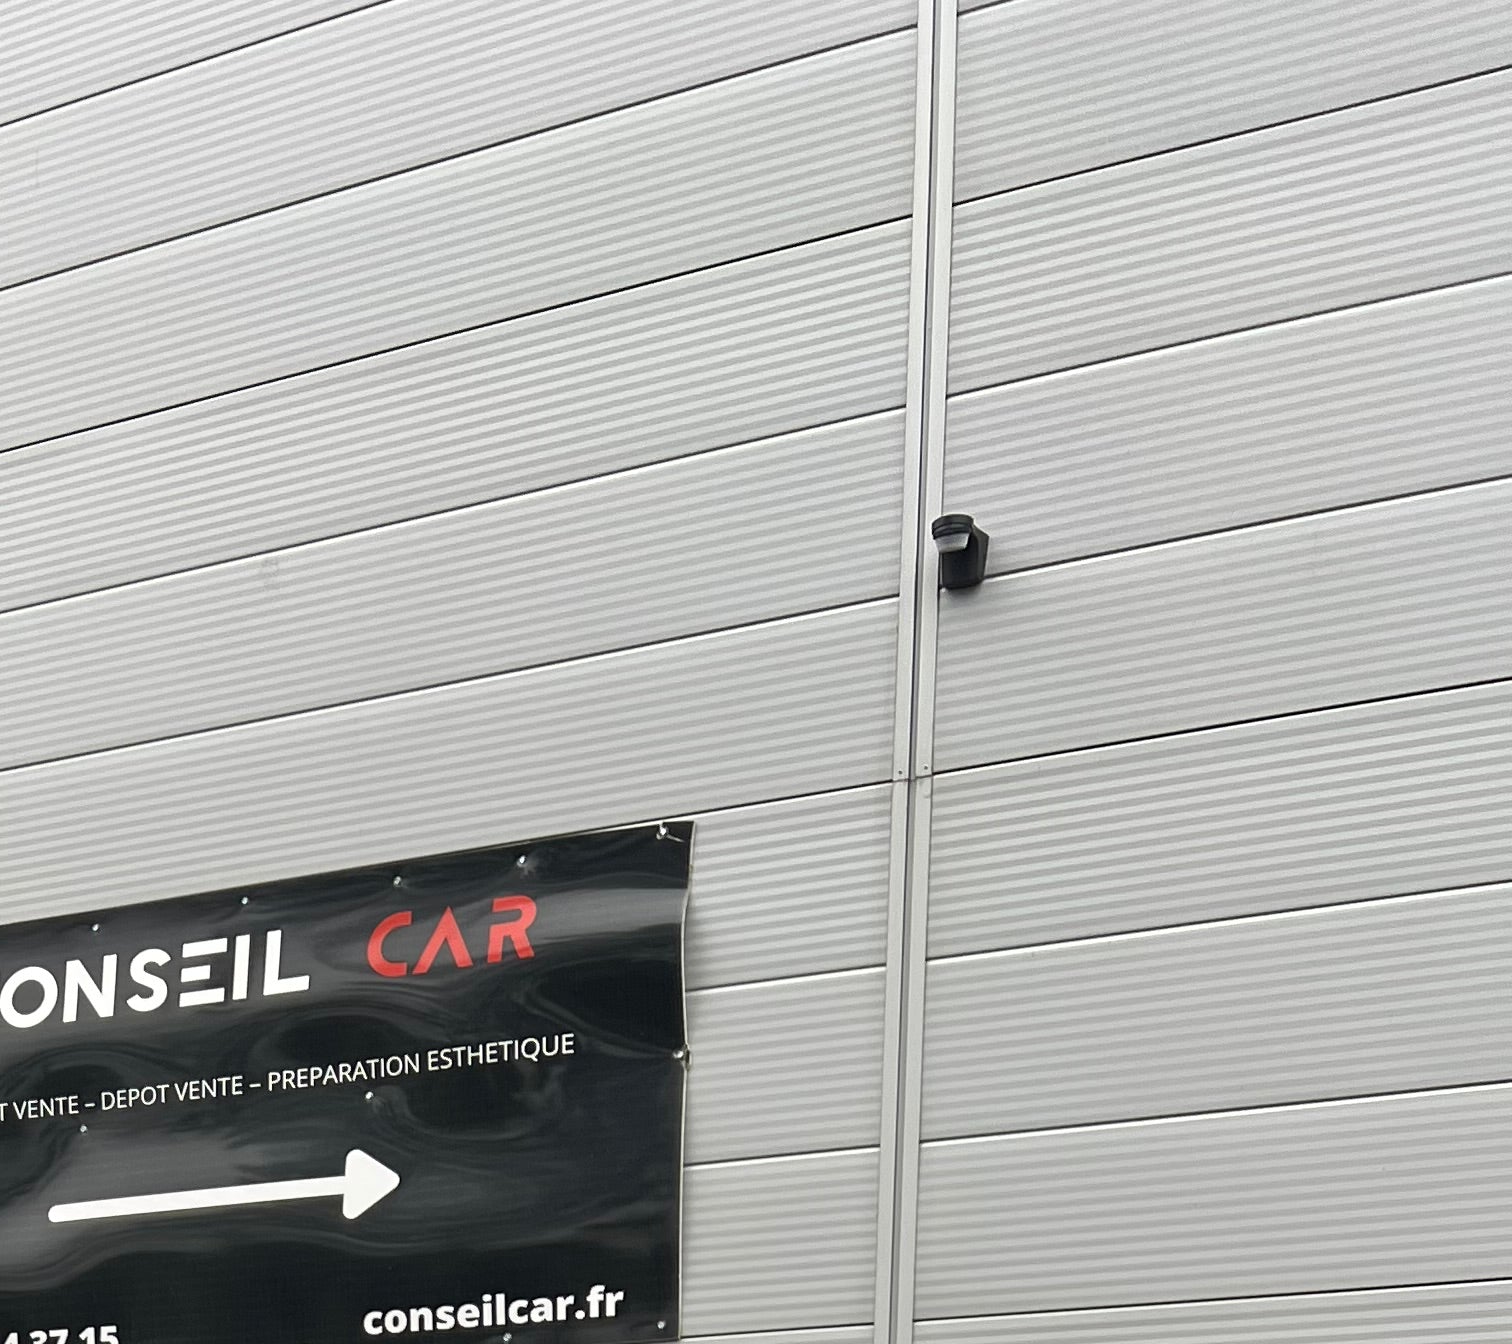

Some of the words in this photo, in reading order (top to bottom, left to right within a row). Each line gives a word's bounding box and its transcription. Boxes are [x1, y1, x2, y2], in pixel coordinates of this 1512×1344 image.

[366, 895, 538, 978] CAR
[12, 1095, 80, 1121] VENTE
[100, 1083, 170, 1111] DEPOT
[174, 1075, 244, 1102] VENTE
[267, 1052, 421, 1092] PREPARATION
[426, 1032, 575, 1072] ESTHETIQUE
[362, 1284, 626, 1336] conseilcar.fr
